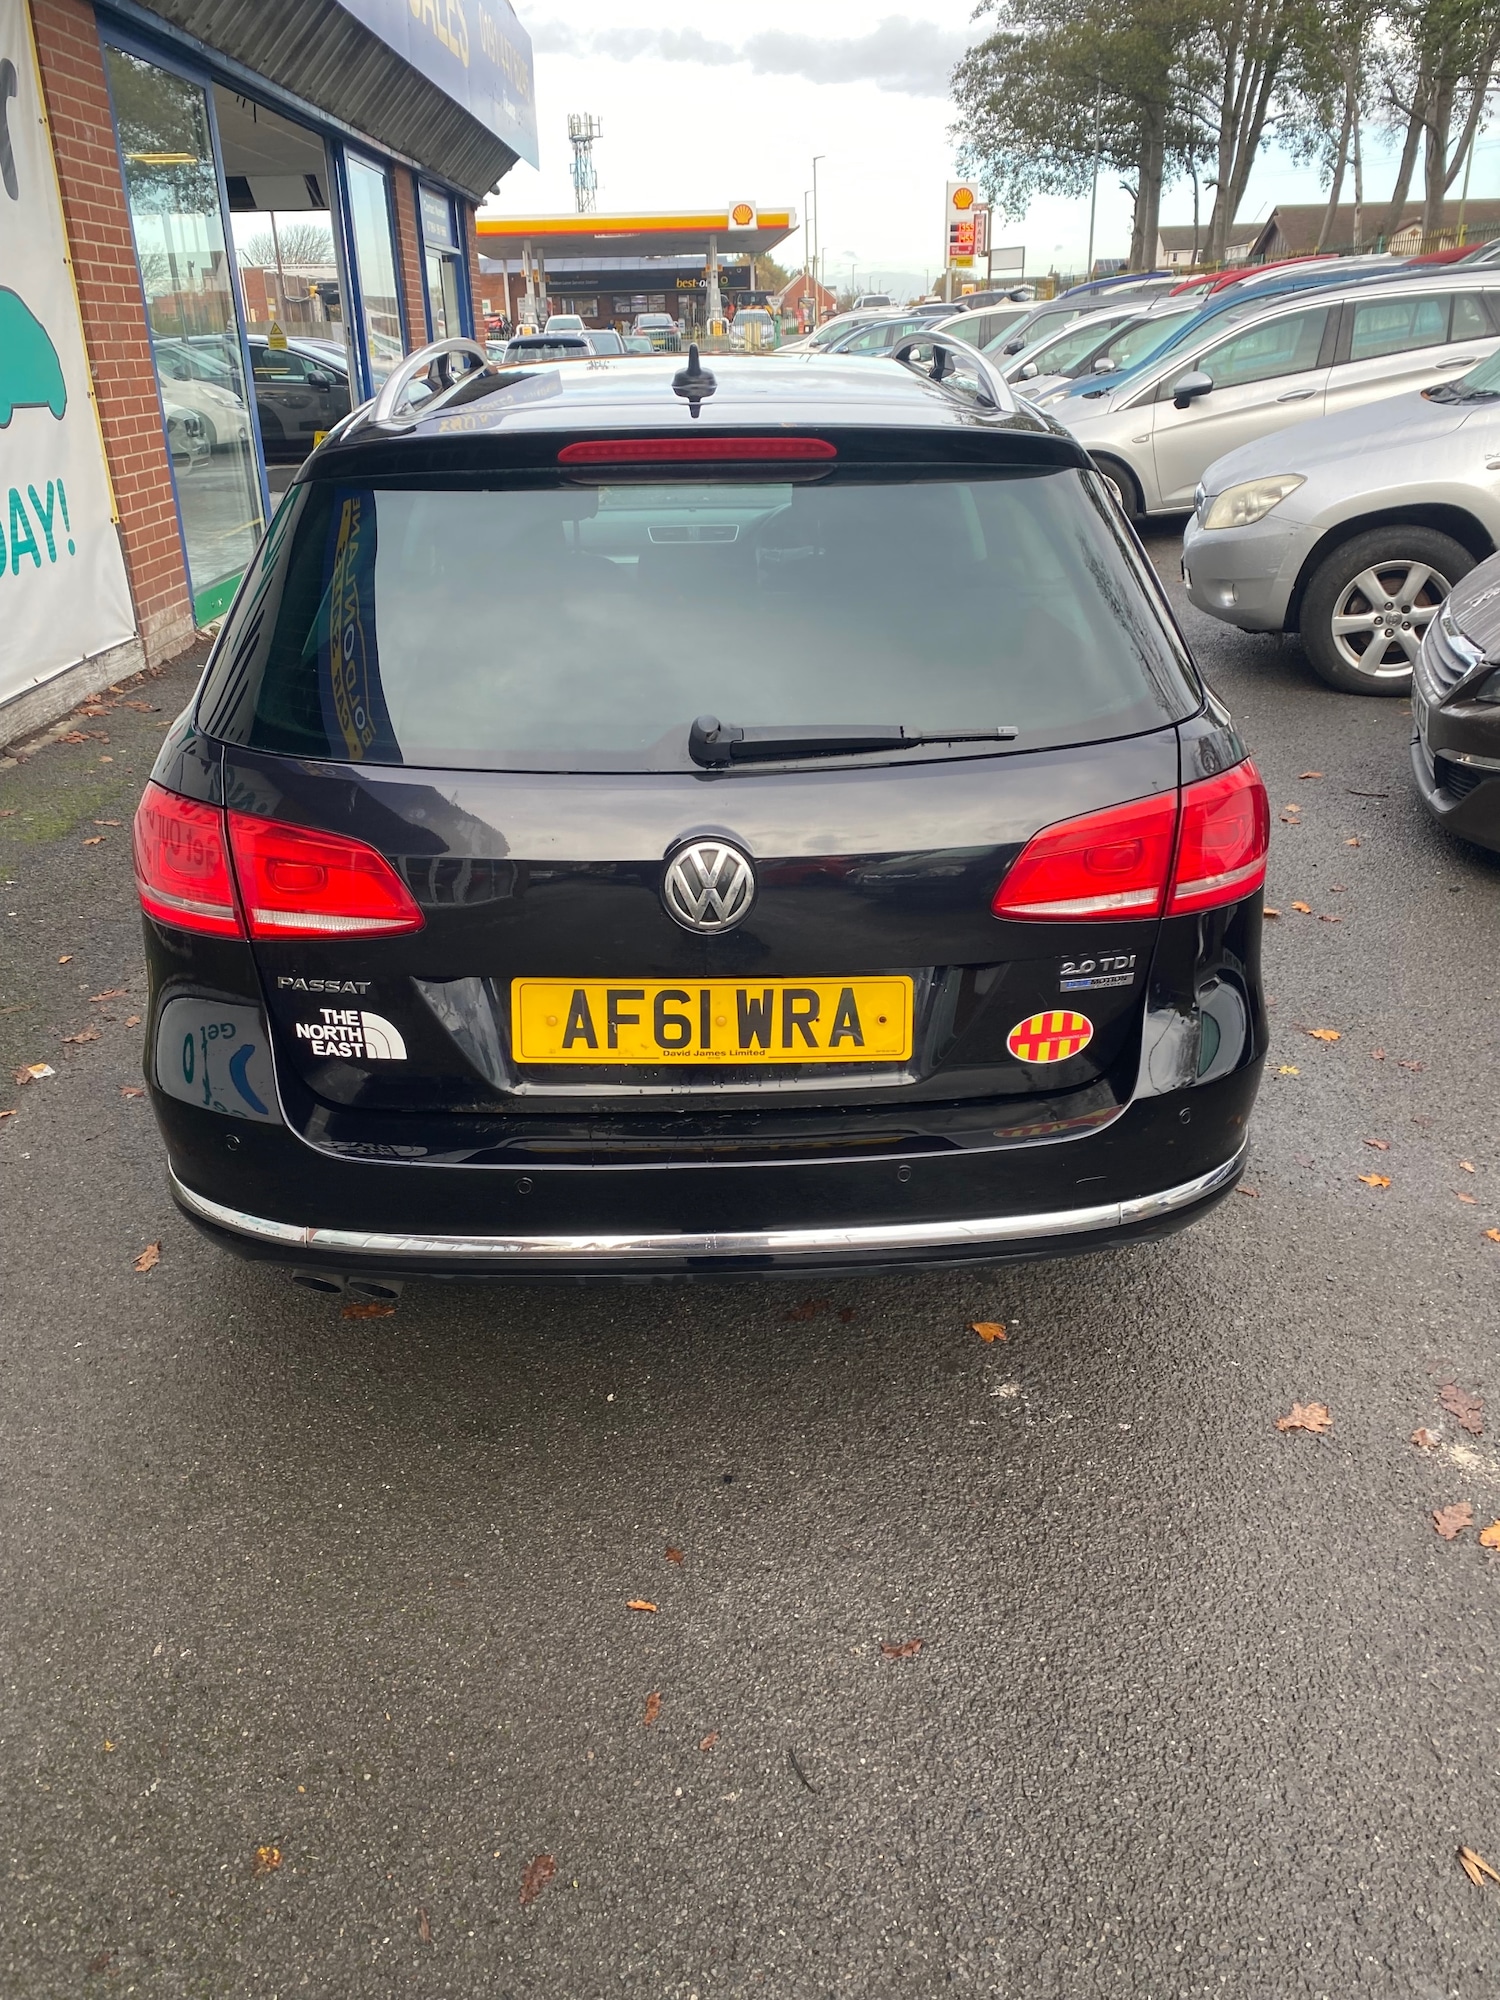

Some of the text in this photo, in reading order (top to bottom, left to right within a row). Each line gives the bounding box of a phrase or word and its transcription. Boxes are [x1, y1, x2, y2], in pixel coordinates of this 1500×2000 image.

[409, 0, 469, 68] ALES
[0, 478, 75, 577] AY!
[1099, 954, 1136, 972] TDI
[277, 976, 371, 995] PASSAT
[319, 1008, 360, 1026] THE
[562, 987, 865, 1049] AF61 WRA
[295, 1023, 363, 1042] NORTH
[311, 1040, 364, 1058] EAST
